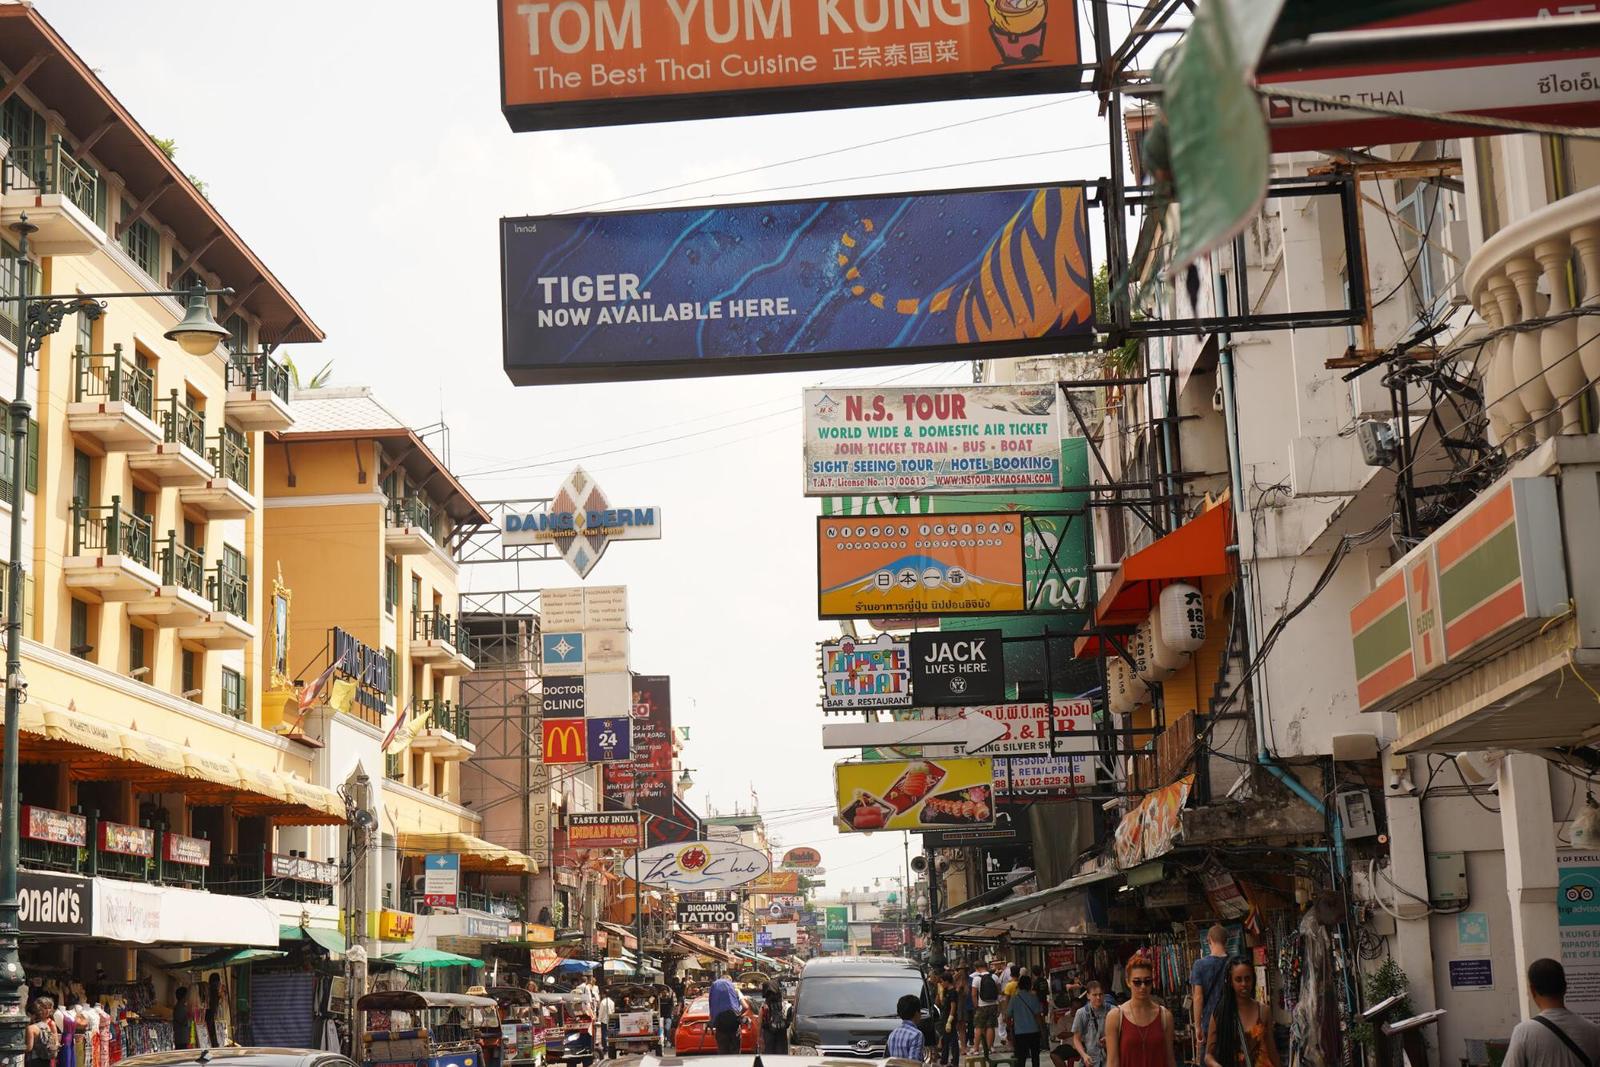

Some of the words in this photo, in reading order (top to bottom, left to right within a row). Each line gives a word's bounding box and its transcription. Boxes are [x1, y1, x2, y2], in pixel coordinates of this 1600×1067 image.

[517, 0, 642, 55] TOM
[667, 0, 793, 46] YUM
[818, 0, 970, 36] KUNG
[832, 39, 959, 71] 正宗泰国菜
[534, 66, 581, 90] The
[591, 63, 648, 86] Best
[655, 58, 711, 81] Thai
[720, 53, 817, 77] Cuisine
[1357, 89, 1404, 107] THAI
[537, 273, 651, 304] TIGER.
[538, 307, 591, 328] NOW
[600, 300, 723, 326] AVAILABLE
[729, 297, 797, 319] HERE.
[845, 394, 894, 422] N.S.
[903, 393, 967, 421] TOUR
[818, 426, 862, 439] WORLD
[867, 425, 899, 438] WIDE
[903, 425, 913, 437] &
[919, 423, 979, 437] DOMESTIC
[983, 423, 1005, 436] AIR
[1009, 422, 1048, 435] TICKET
[834, 443, 863, 456] JOIN
[868, 442, 907, 455] TICKET
[911, 441, 948, 454] TRAIN
[962, 440, 986, 452] BUS
[1001, 439, 1033, 451] BOAT
[813, 460, 848, 473] SIGHT
[854, 459, 896, 472] SEEING
[901, 458, 933, 471] TOUR
[951, 458, 989, 471] HOTEL
[993, 456, 1052, 469] BOOKING
[837, 475, 865, 487] License
[867, 476, 881, 486] No.
[884, 475, 926, 486] 13/00613
[506, 511, 575, 532] DANG
[585, 508, 654, 528] DERM
[827, 527, 908, 537] NIPPON
[922, 524, 1013, 536] ICHIBAN
[877, 570, 964, 587] 日本一番
[1412, 560, 1433, 665] 7
[924, 641, 986, 662] JACK
[925, 664, 955, 674] LIVES
[543, 685, 584, 695] DOCTOR
[543, 699, 584, 711] CLINIC
[827, 699, 843, 707] BAR
[847, 698, 854, 706] &
[857, 696, 910, 706] RESTAURANT
[599, 733, 618, 747] 24
[1003, 742, 1036, 751] SILVER
[573, 816, 598, 824] TASTE
[599, 815, 610, 823] OF
[611, 815, 635, 823] INDIA
[534, 803, 546, 865] FOOD
[571, 826, 608, 838] INDIAN
[610, 825, 638, 838] FOOD
[641, 853, 684, 881] The
[702, 857, 760, 875] Club
[687, 904, 727, 912] BIGGAINK
[680, 912, 735, 923] TATTOO
[1566, 930, 1590, 938] KUNG
